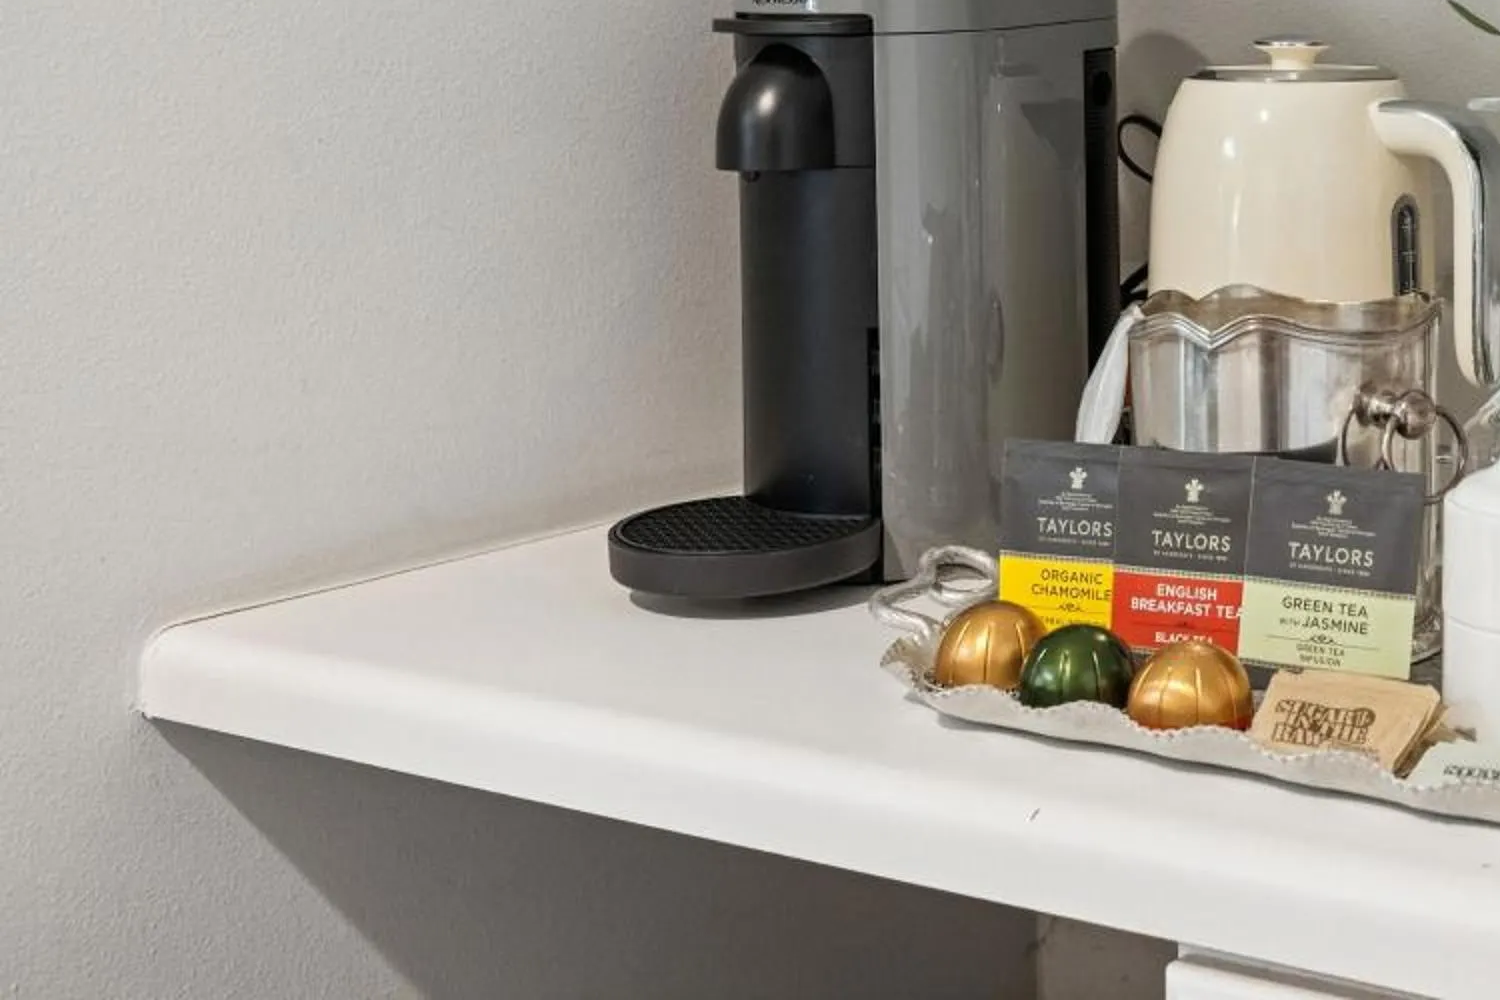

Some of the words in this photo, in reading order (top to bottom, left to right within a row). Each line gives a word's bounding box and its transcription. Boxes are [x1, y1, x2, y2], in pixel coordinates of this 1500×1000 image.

[1037, 516, 1113, 537] TAYLORS
[1151, 529, 1231, 553] TAYLORS
[1288, 541, 1374, 568] TAYLORS
[1040, 567, 1103, 585] ORGANIC
[1031, 583, 1112, 601] CHAMOMILE
[1156, 583, 1217, 601] ENGLISH
[1130, 596, 1212, 617] BREAKFAST
[1281, 596, 1333, 613] GREEN
[1338, 603, 1368, 619] TEA
[1302, 615, 1369, 635] JASMINE
